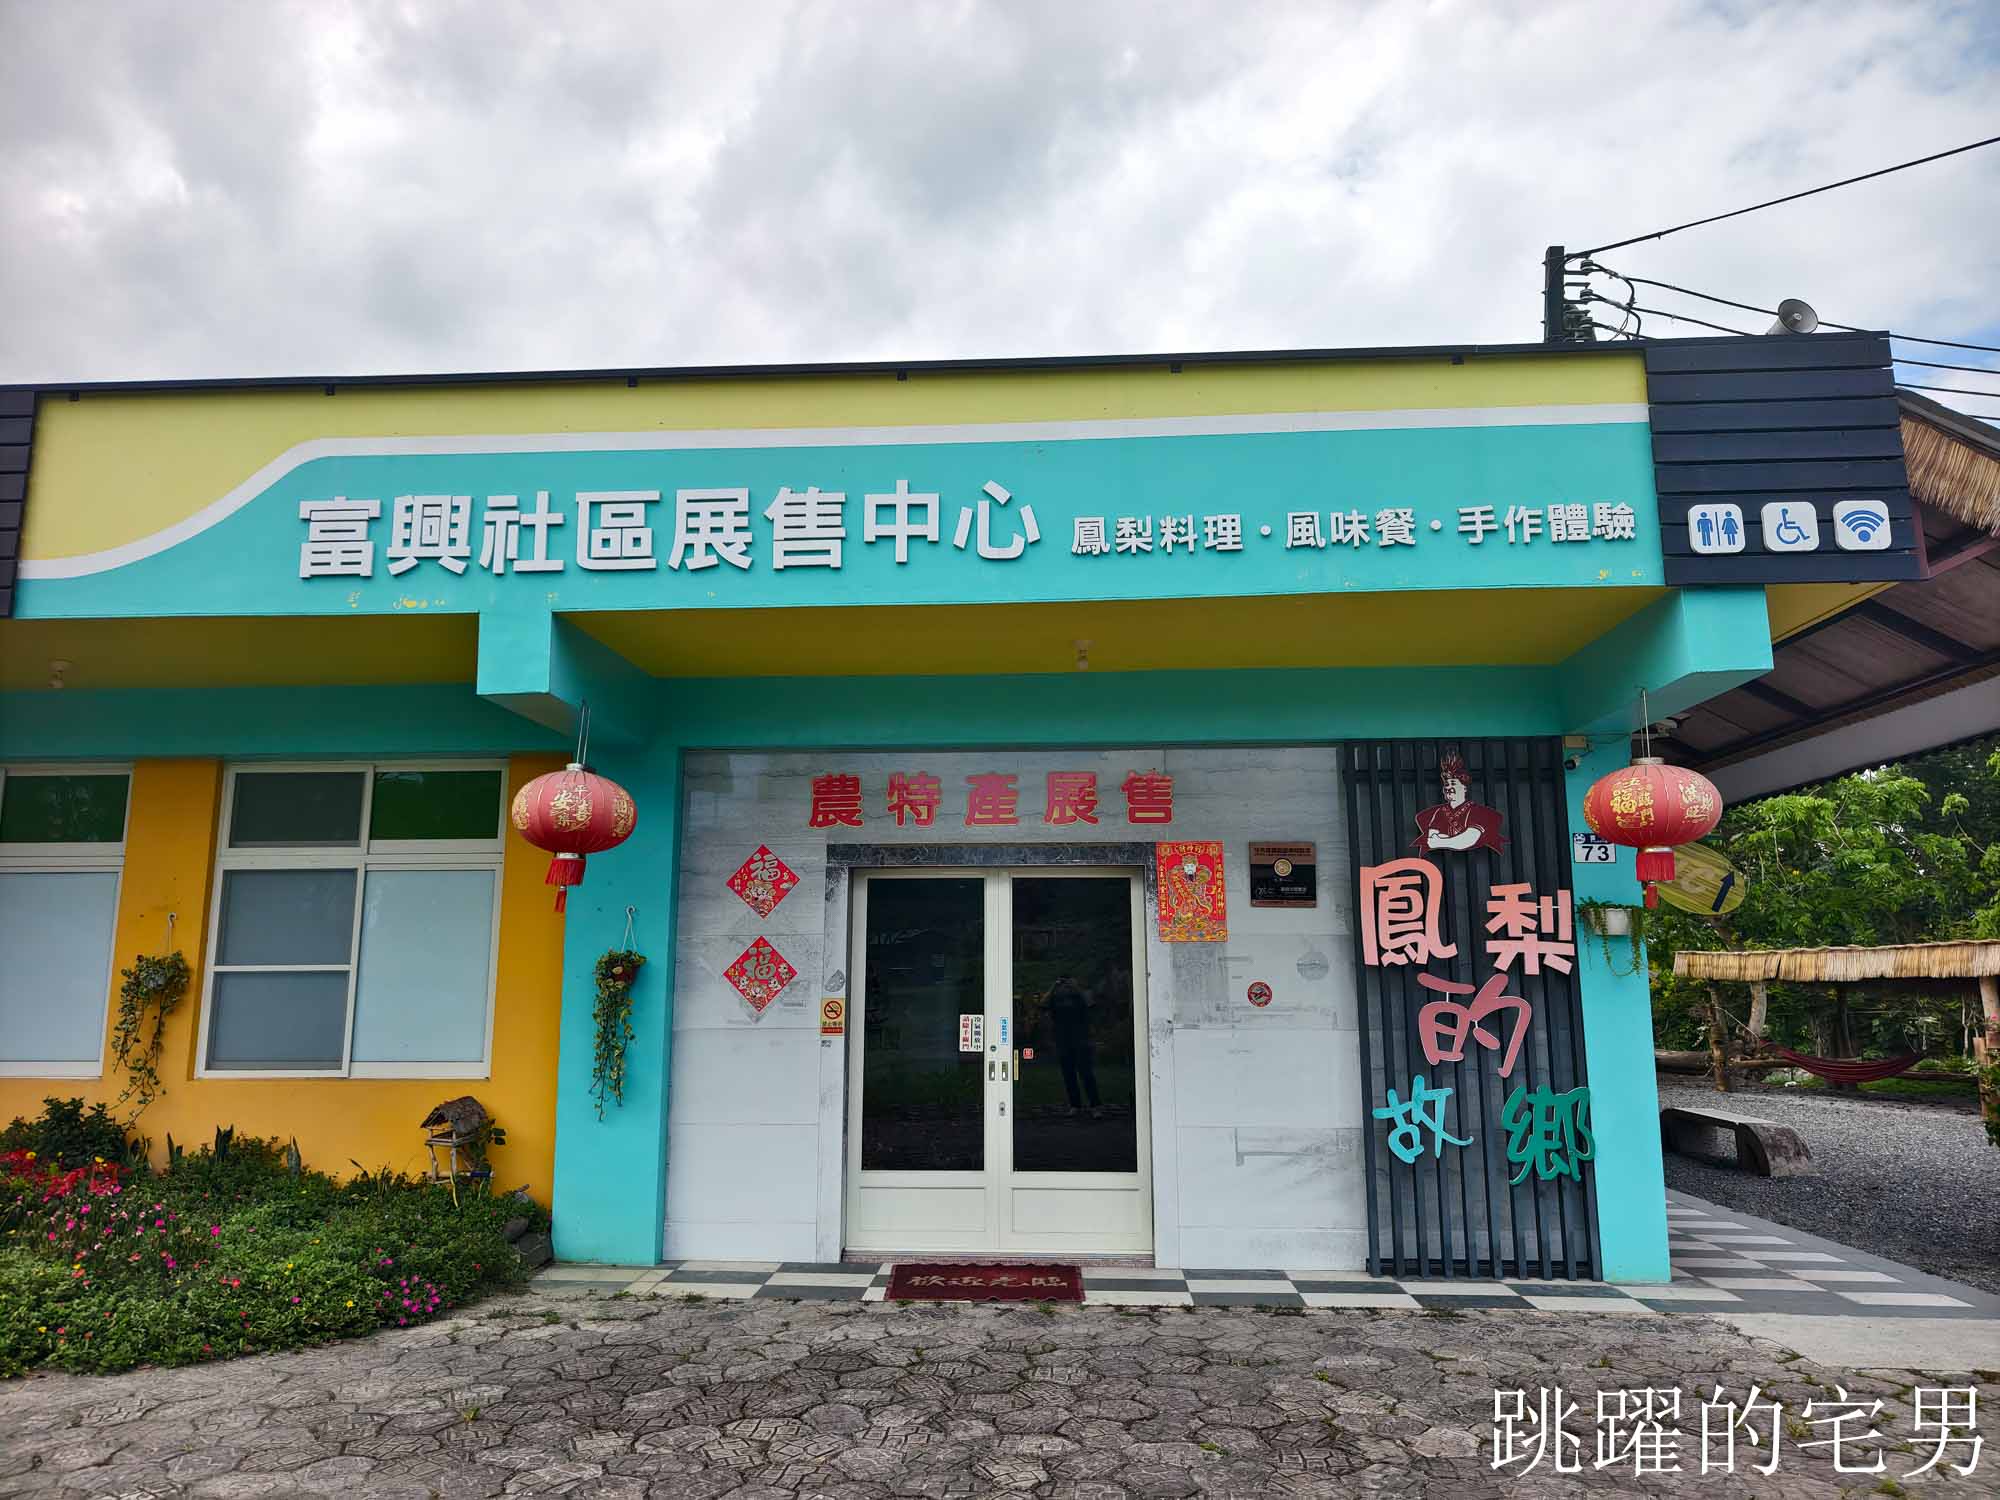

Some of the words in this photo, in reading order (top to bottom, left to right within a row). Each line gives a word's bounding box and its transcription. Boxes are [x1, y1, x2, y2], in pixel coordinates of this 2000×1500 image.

[299, 479, 1041, 578] 富興社區展售中心
[808, 769, 1176, 829] 農特產展售
[750, 854, 781, 882] 福
[1581, 845, 1610, 862] 73
[1360, 857, 1575, 975] 鳳梨
[742, 946, 777, 980] 福
[1417, 973, 1532, 1079] 的
[1372, 1075, 1596, 1185] 故鄉
